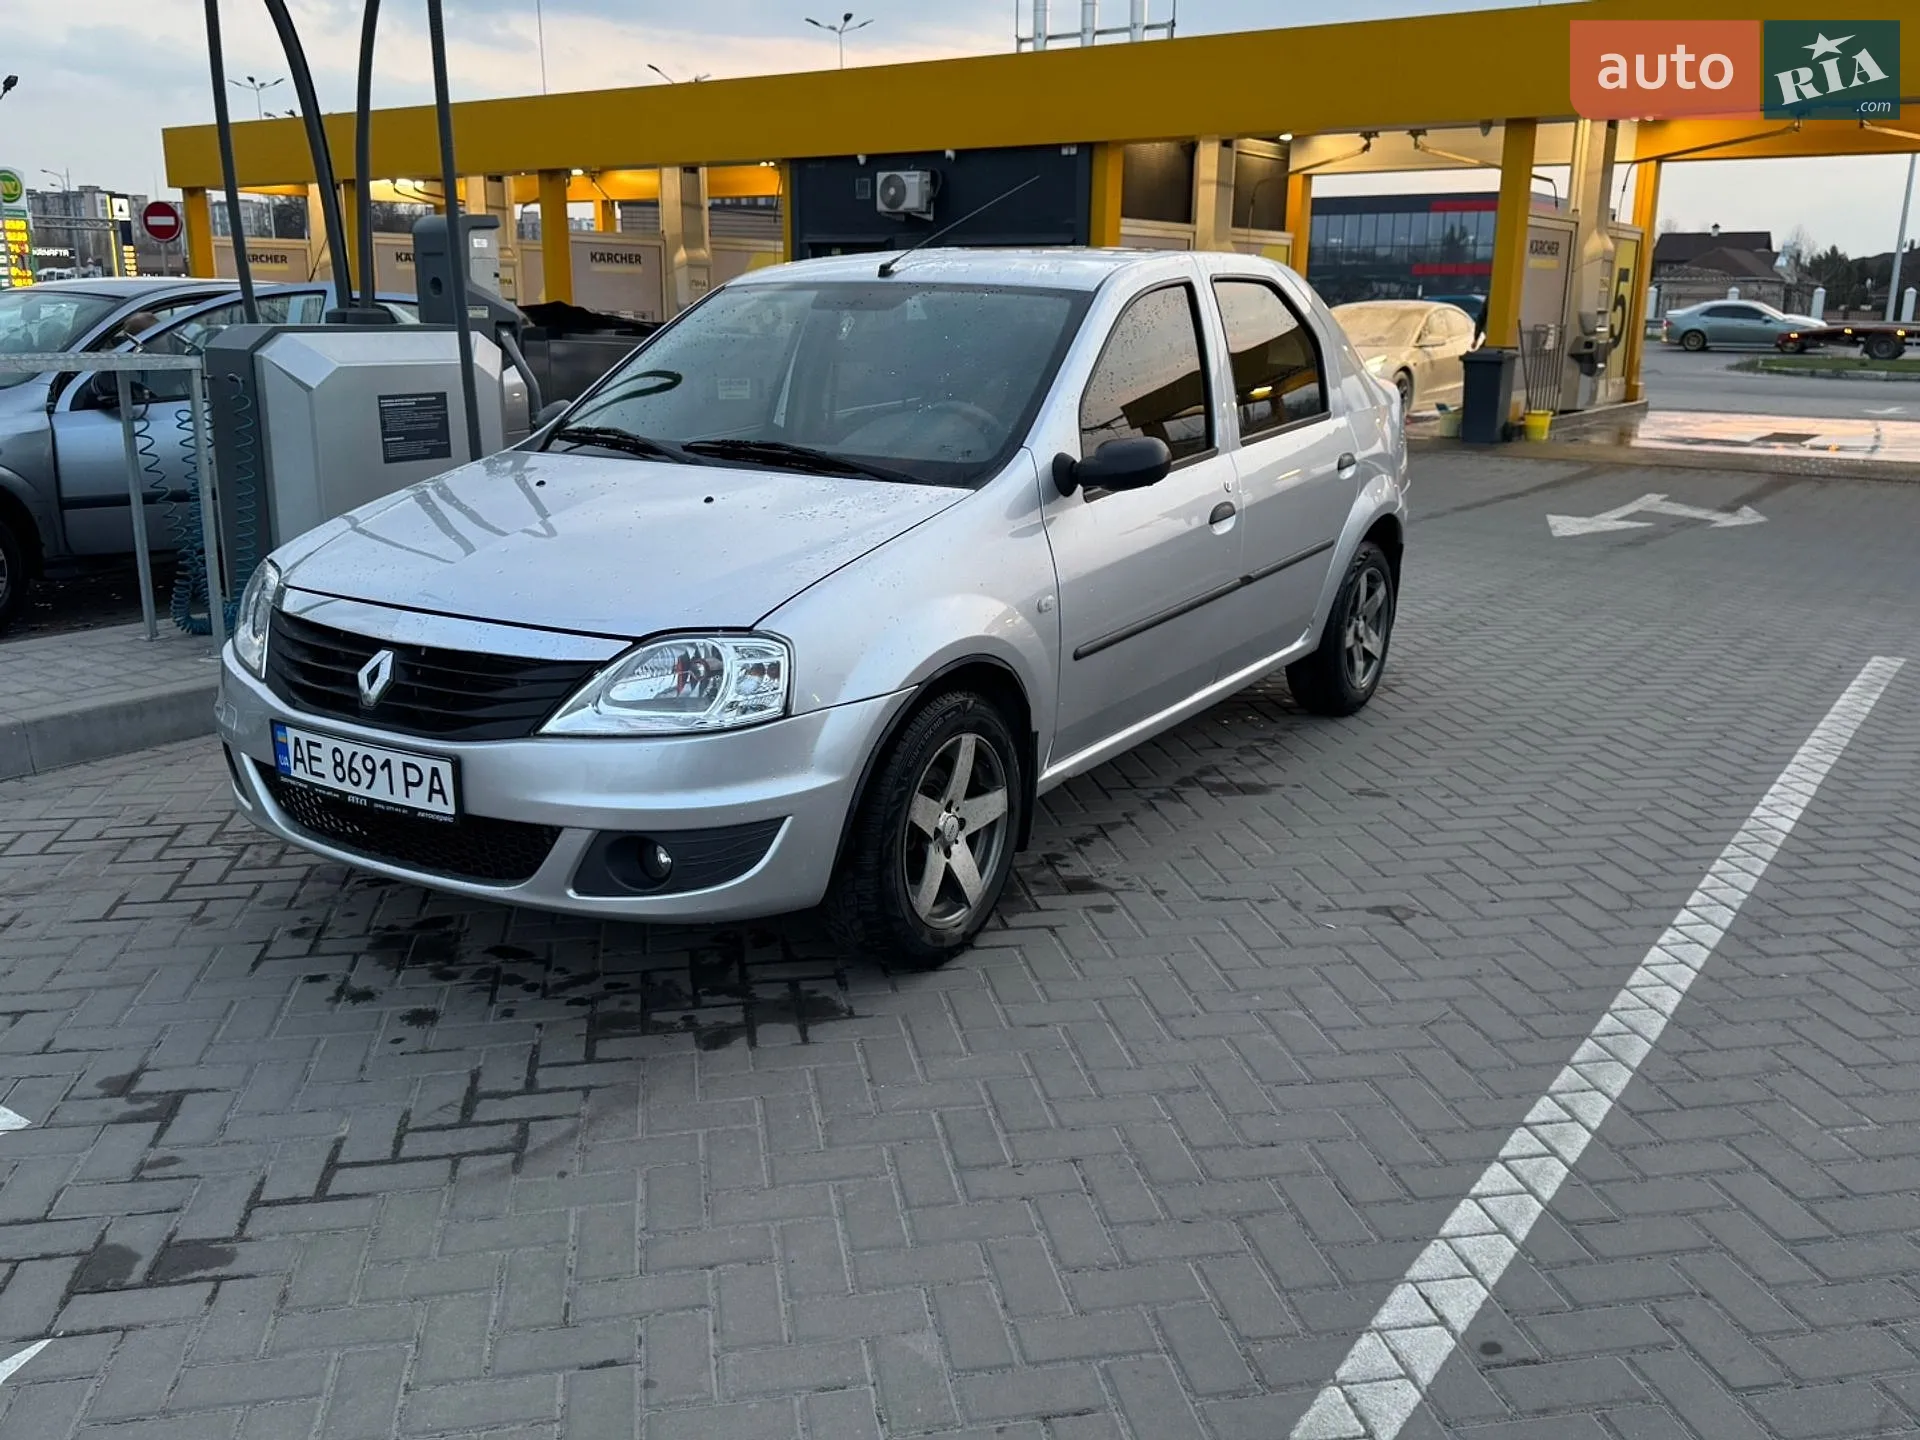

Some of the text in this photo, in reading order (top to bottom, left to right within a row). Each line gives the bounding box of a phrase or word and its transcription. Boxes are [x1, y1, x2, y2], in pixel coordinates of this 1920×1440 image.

[279, 753, 290, 768] UA
[293, 736, 449, 806] AE 8691 PA
